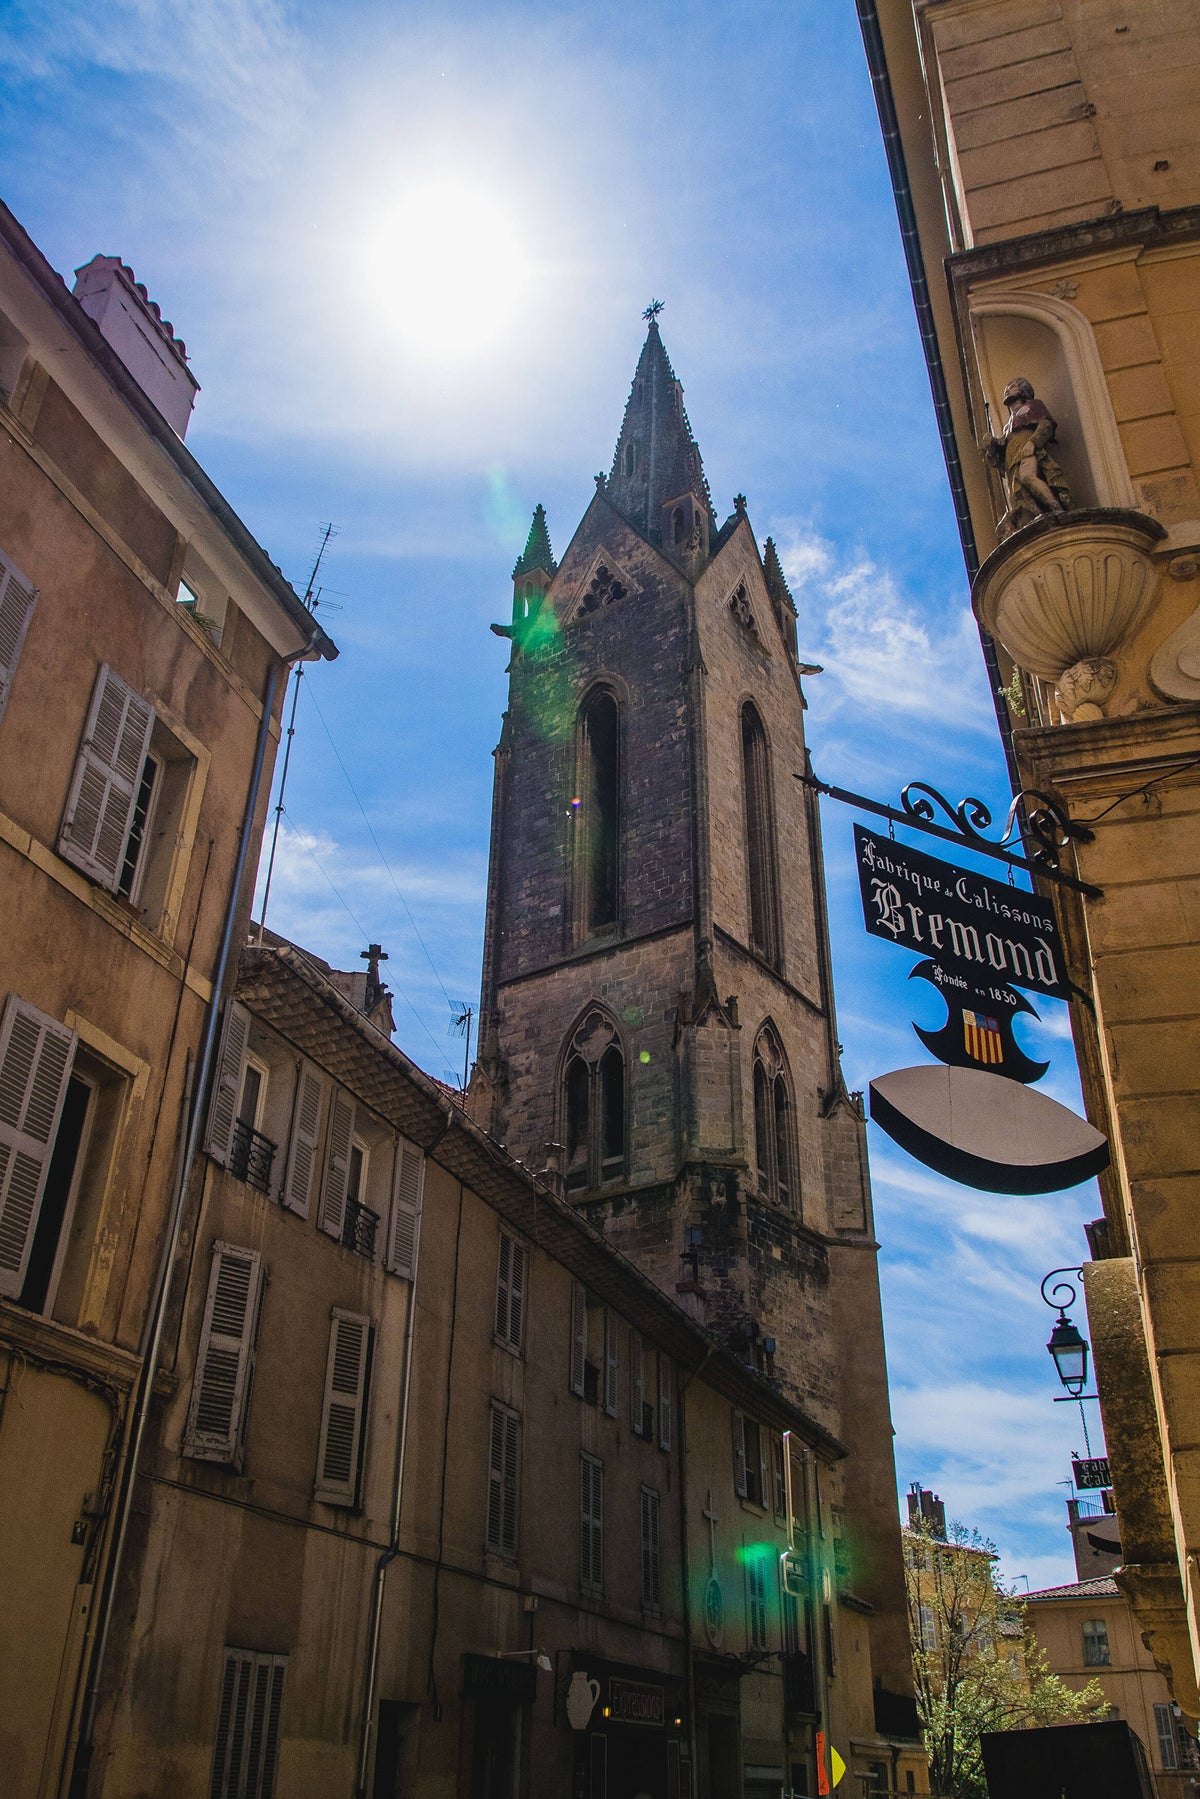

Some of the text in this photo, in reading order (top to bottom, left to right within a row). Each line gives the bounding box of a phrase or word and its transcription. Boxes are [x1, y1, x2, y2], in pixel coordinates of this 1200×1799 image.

[861, 837, 1054, 932] Fabrique de Calissons
[870, 877, 1059, 986] Bremond
[974, 988, 986, 996] en
[988, 987, 1017, 1005] 1830
[1080, 1471, 1113, 1487] Cali
